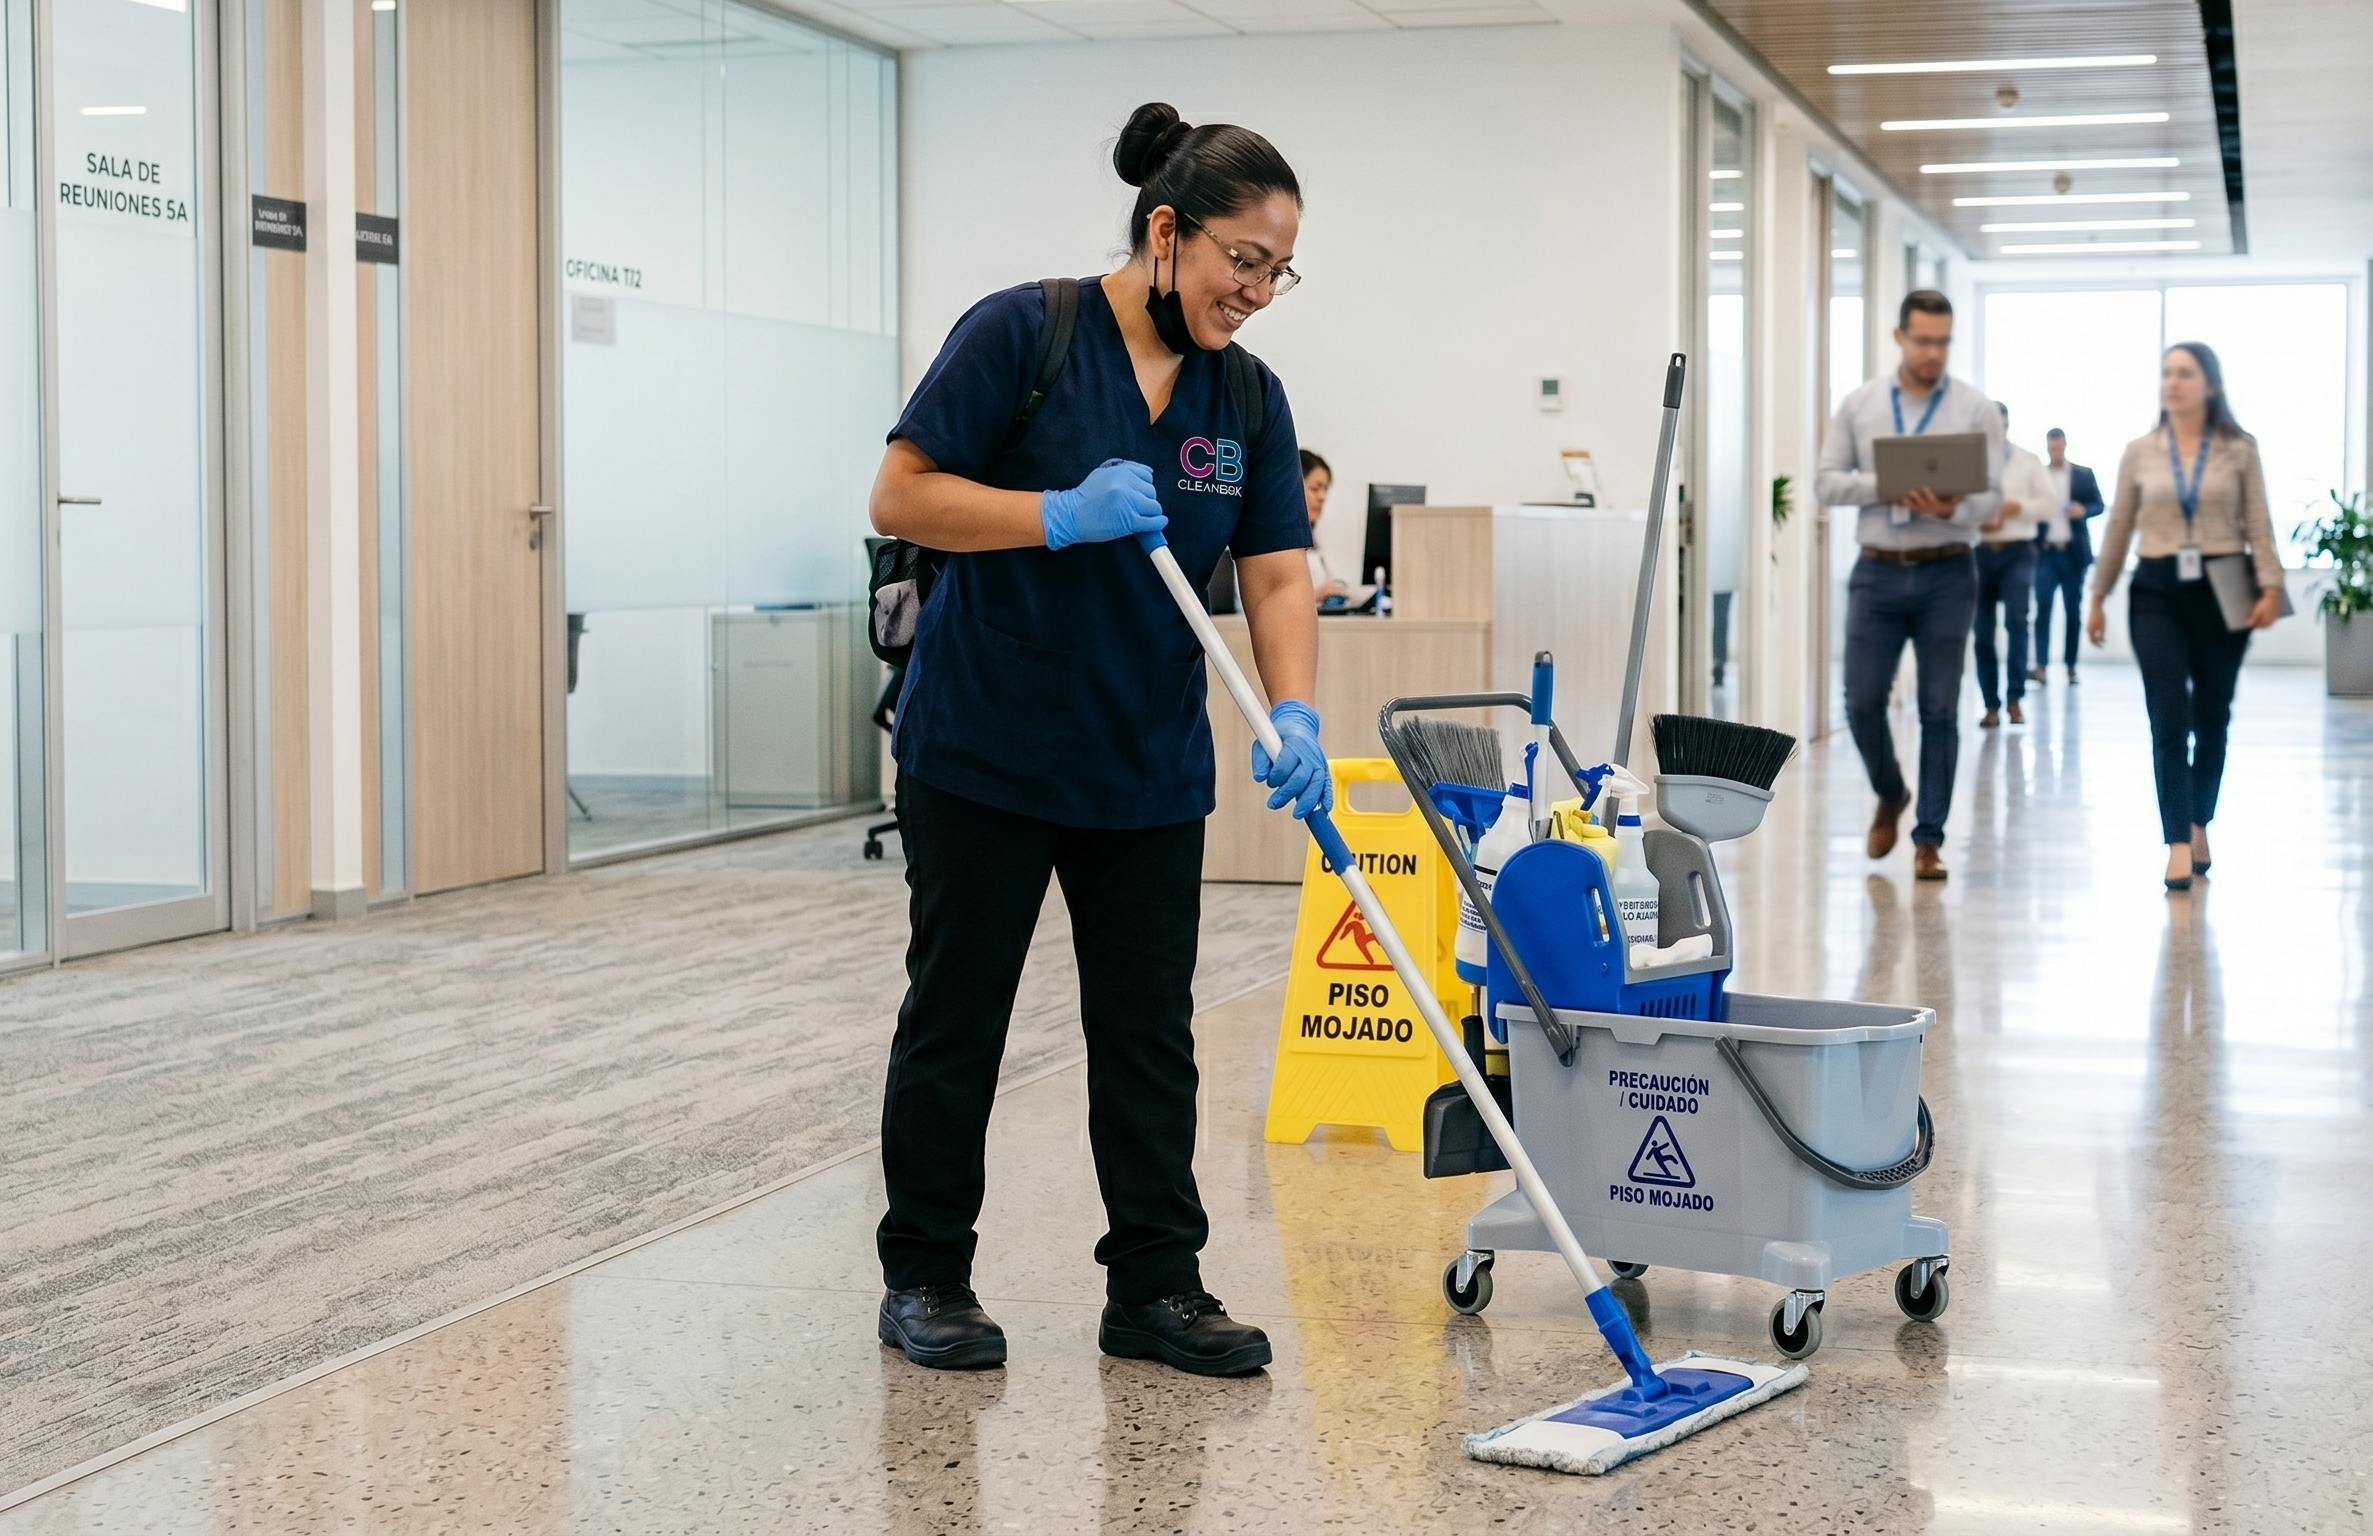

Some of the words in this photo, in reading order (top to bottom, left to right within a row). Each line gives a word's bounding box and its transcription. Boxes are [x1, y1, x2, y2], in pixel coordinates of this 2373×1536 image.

[86, 152, 133, 180] SALA
[138, 161, 161, 184] DE
[60, 182, 161, 218] REUNIONES
[166, 199, 188, 222] 5A
[566, 258, 619, 284] OFICINA
[1180, 436, 1244, 483] CB
[1328, 983, 1389, 1008] PISO
[1301, 1015, 1414, 1043] MOJADO
[1609, 1070, 1710, 1096] PRECAUCIÓN
[1628, 1092, 1699, 1115] CUIDADO
[1610, 1185, 1645, 1204] PISO
[1649, 1189, 1714, 1212] MOJADO
